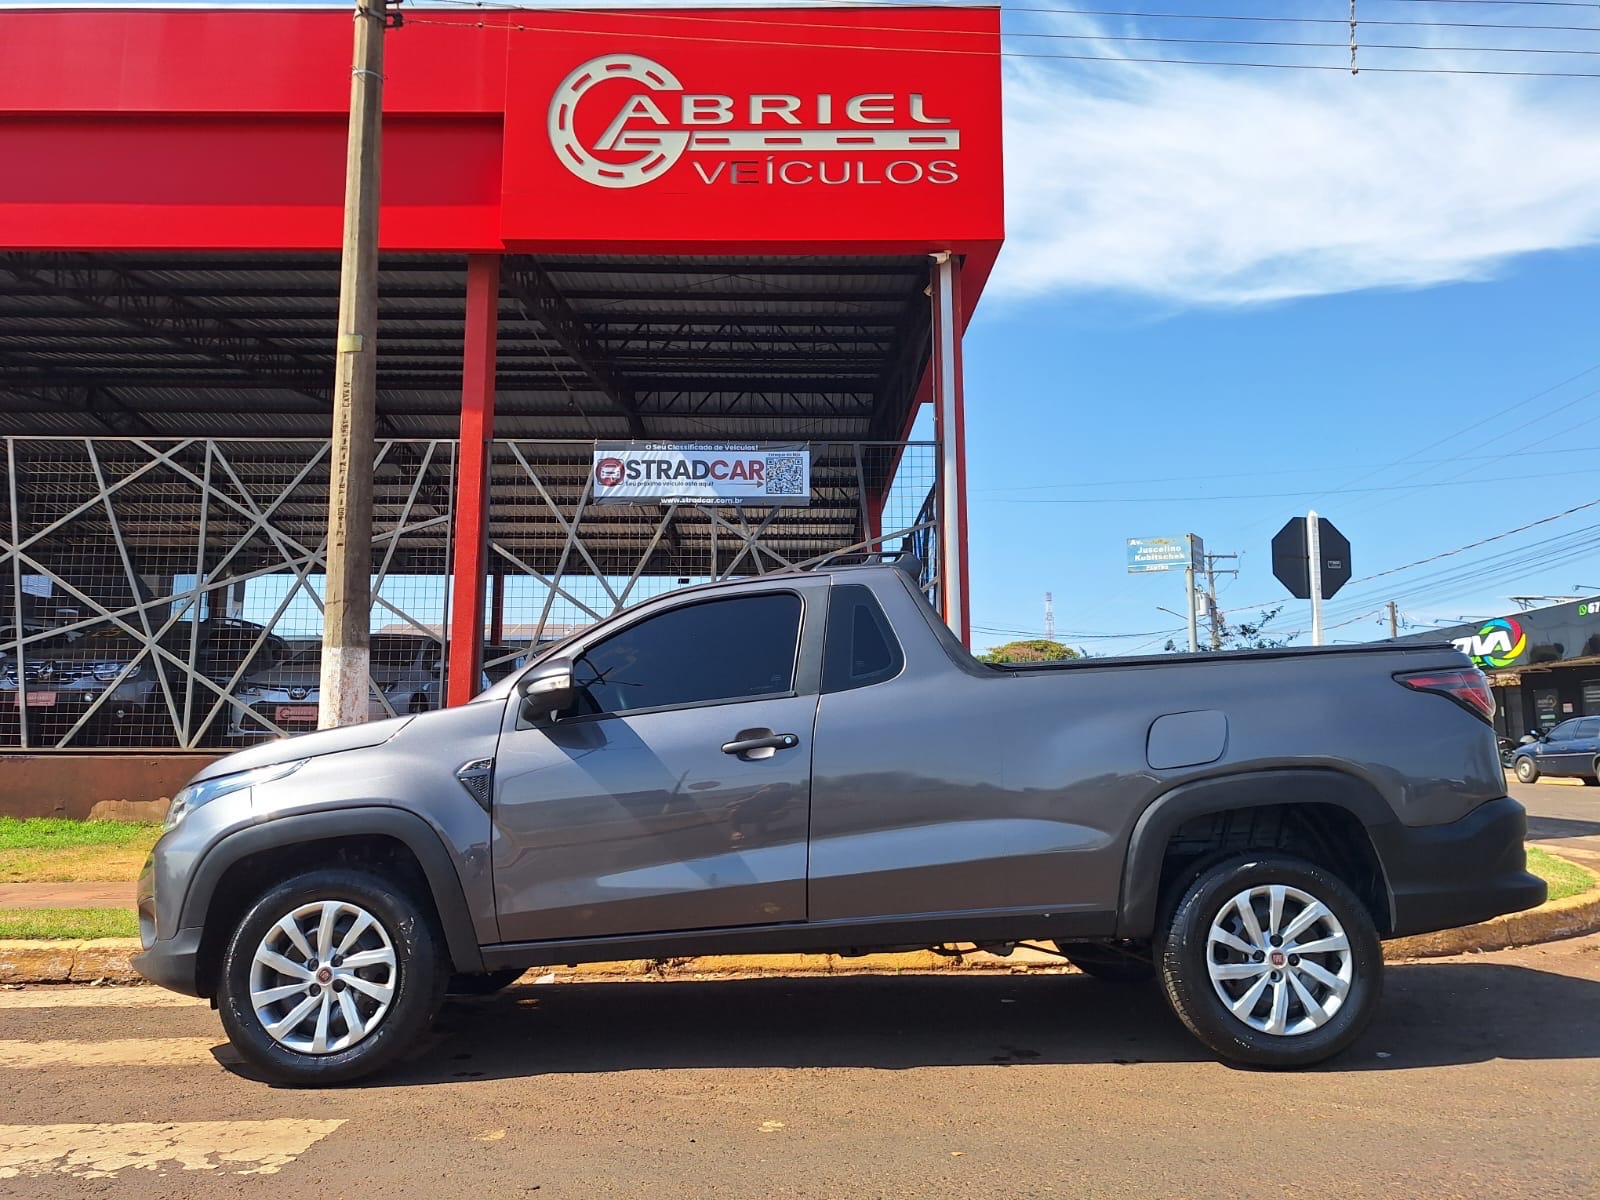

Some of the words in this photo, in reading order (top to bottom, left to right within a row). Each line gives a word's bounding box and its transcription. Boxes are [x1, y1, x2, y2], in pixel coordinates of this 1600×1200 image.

[547, 53, 957, 189] GABRIEL
[692, 155, 960, 185] VEÍCULOS
[652, 443, 666, 451] Seu
[667, 443, 712, 451] Classificado
[713, 443, 723, 451] de
[625, 459, 765, 481] STRADCAR
[660, 496, 744, 505] www.stradcar.com.br
[1137, 545, 1182, 554] Juscelino
[1134, 552, 1185, 561] Kubitschek
